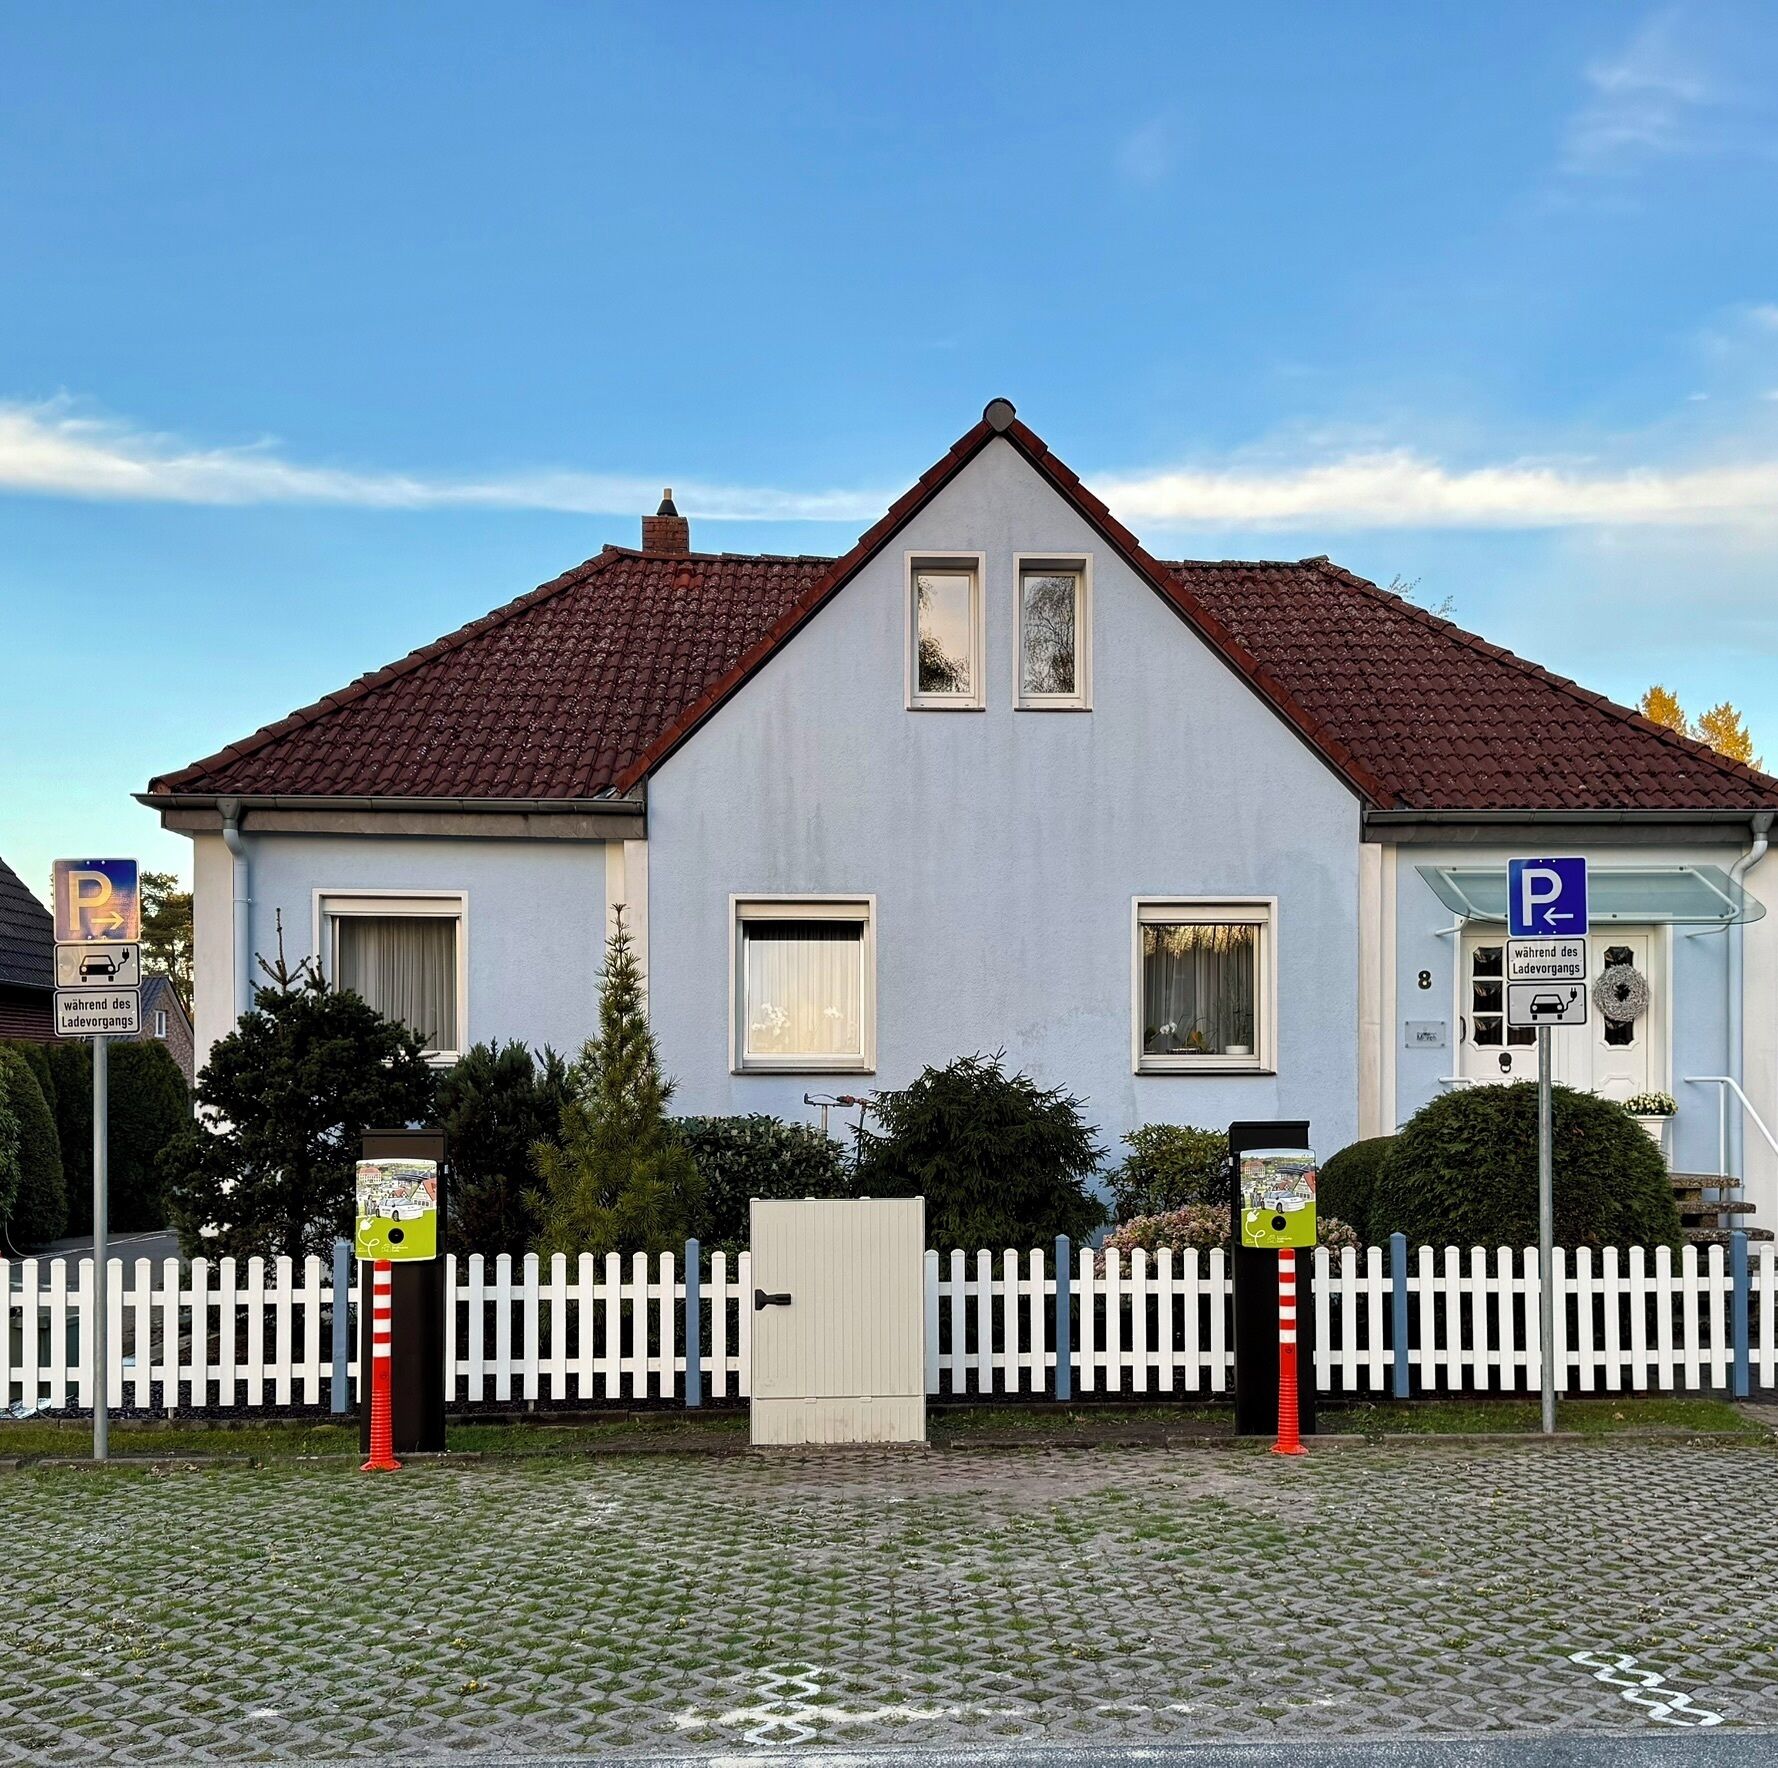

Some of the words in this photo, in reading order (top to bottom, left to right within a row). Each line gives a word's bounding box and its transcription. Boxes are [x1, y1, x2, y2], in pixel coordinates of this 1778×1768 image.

[68, 870, 113, 931] P
[1521, 868, 1563, 927] P
[1514, 946, 1556, 958] während
[1561, 946, 1578, 957] des
[1512, 963, 1580, 976] Ladevorgangs
[1418, 970, 1432, 990] 8
[63, 998, 107, 1011] während
[112, 998, 131, 1010] des
[61, 1016, 134, 1030] Ladevorgangs
